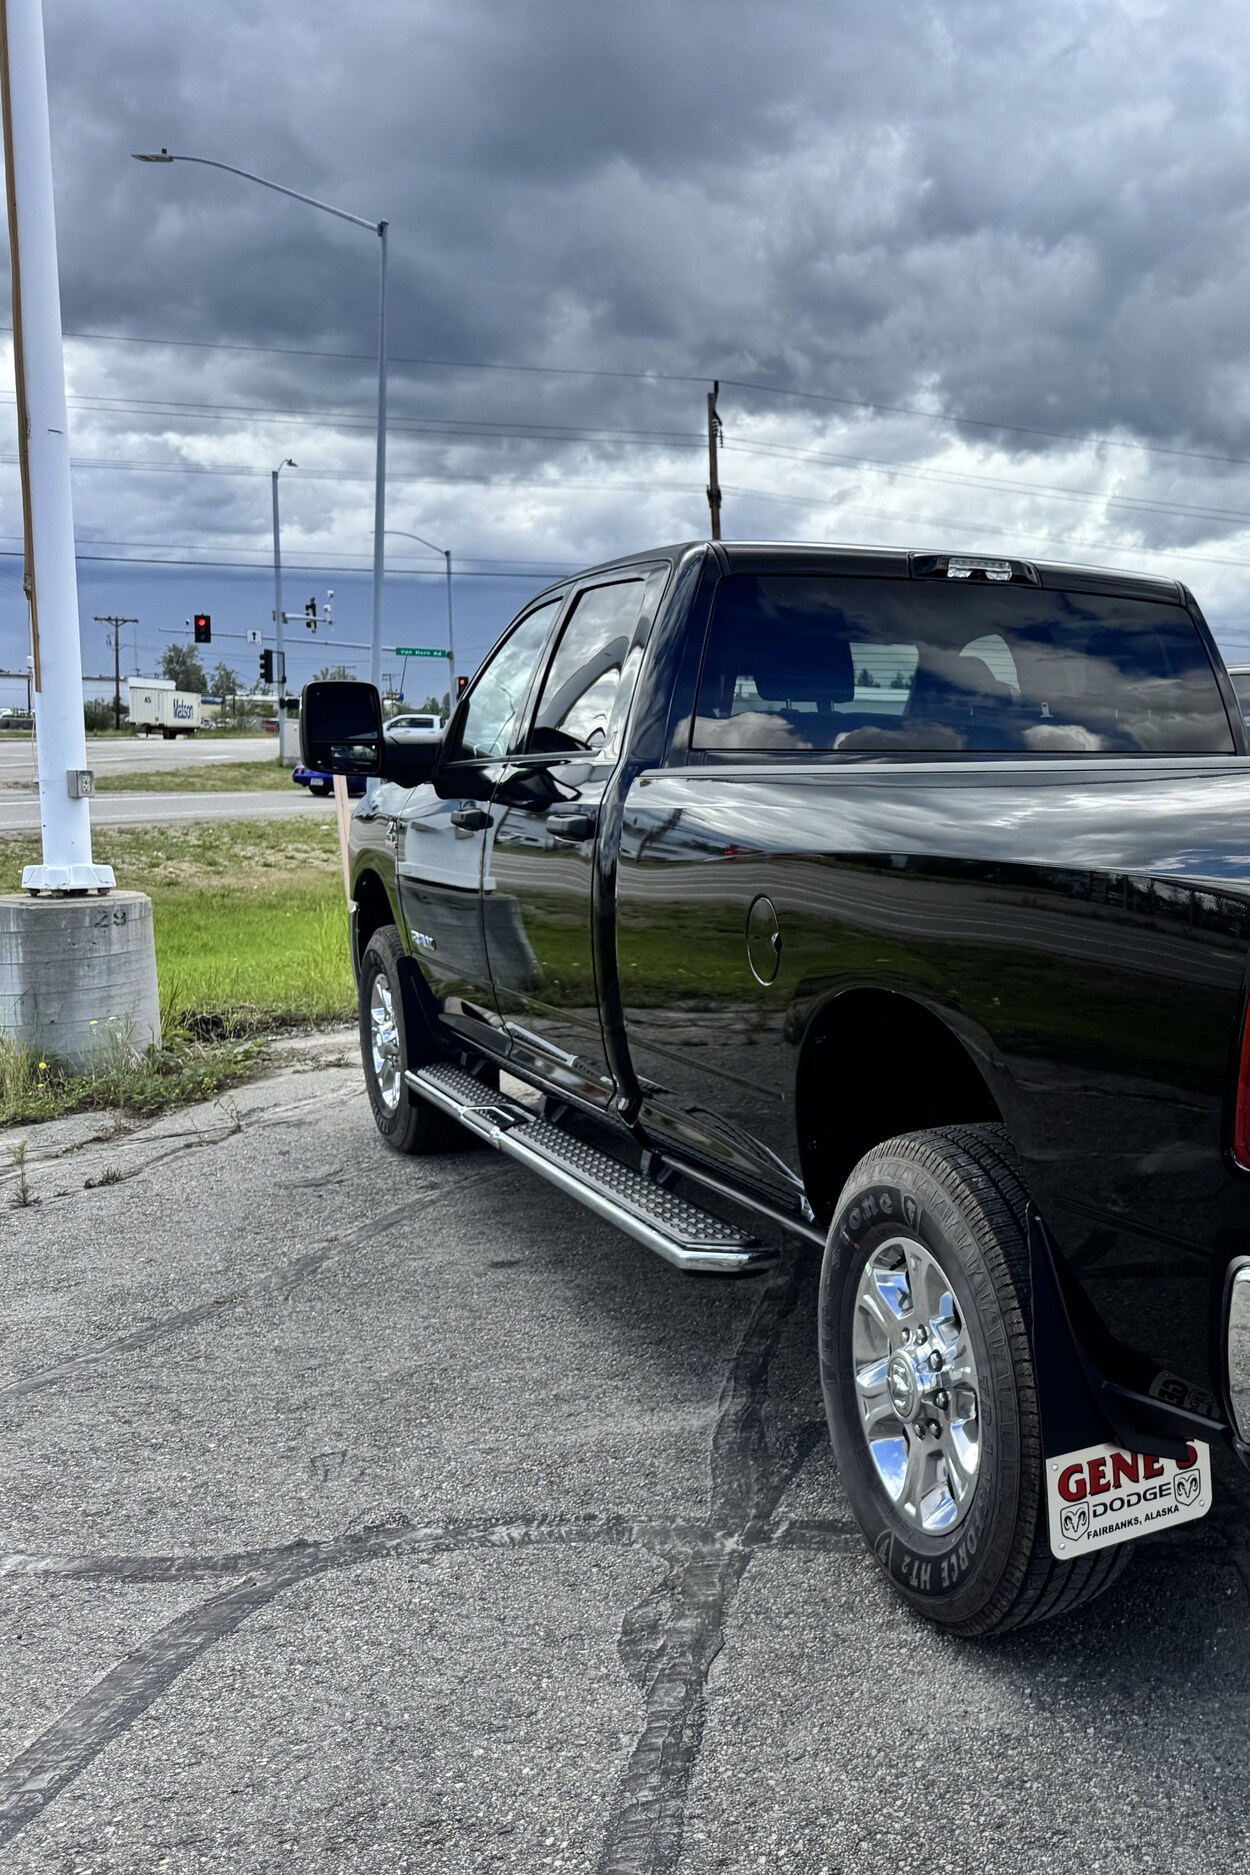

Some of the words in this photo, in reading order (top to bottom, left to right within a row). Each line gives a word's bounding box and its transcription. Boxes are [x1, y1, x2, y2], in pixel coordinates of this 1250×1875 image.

[173, 698, 194, 719] Matson
[94, 910, 127, 927] 29
[1092, 1482, 1172, 1518] DODGE
[1087, 1516, 1142, 1540] FAIRBANKS,
[1144, 1504, 1180, 1523] ALASKA
